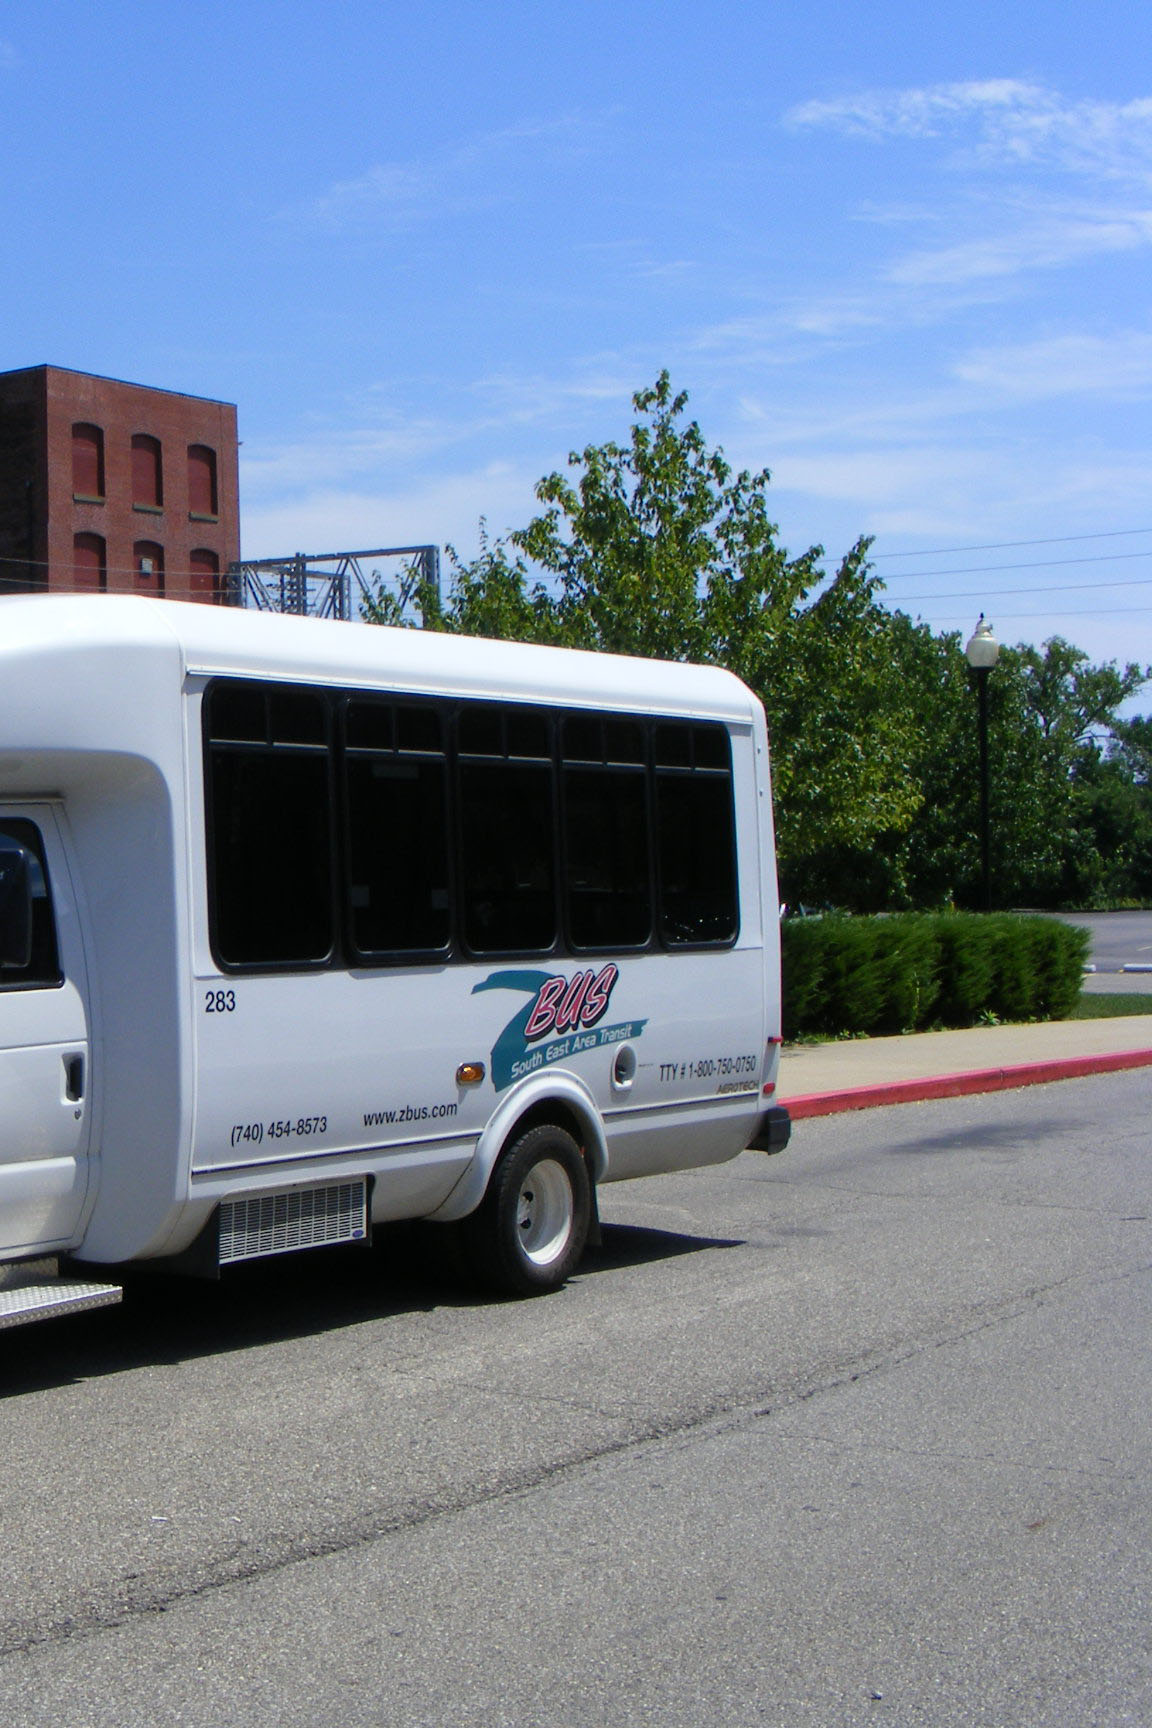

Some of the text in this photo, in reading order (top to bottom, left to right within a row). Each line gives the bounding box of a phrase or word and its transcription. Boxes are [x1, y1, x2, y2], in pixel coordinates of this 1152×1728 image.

[205, 990, 236, 1013] 283
[523, 962, 619, 1042] BUS
[511, 1024, 633, 1079] South East Area Transit
[660, 1063, 679, 1082] TTY
[689, 1055, 757, 1079] 1-800-750-0750
[363, 1103, 458, 1127] www.zbus.com
[231, 1116, 328, 1148] (740) 454-8573
